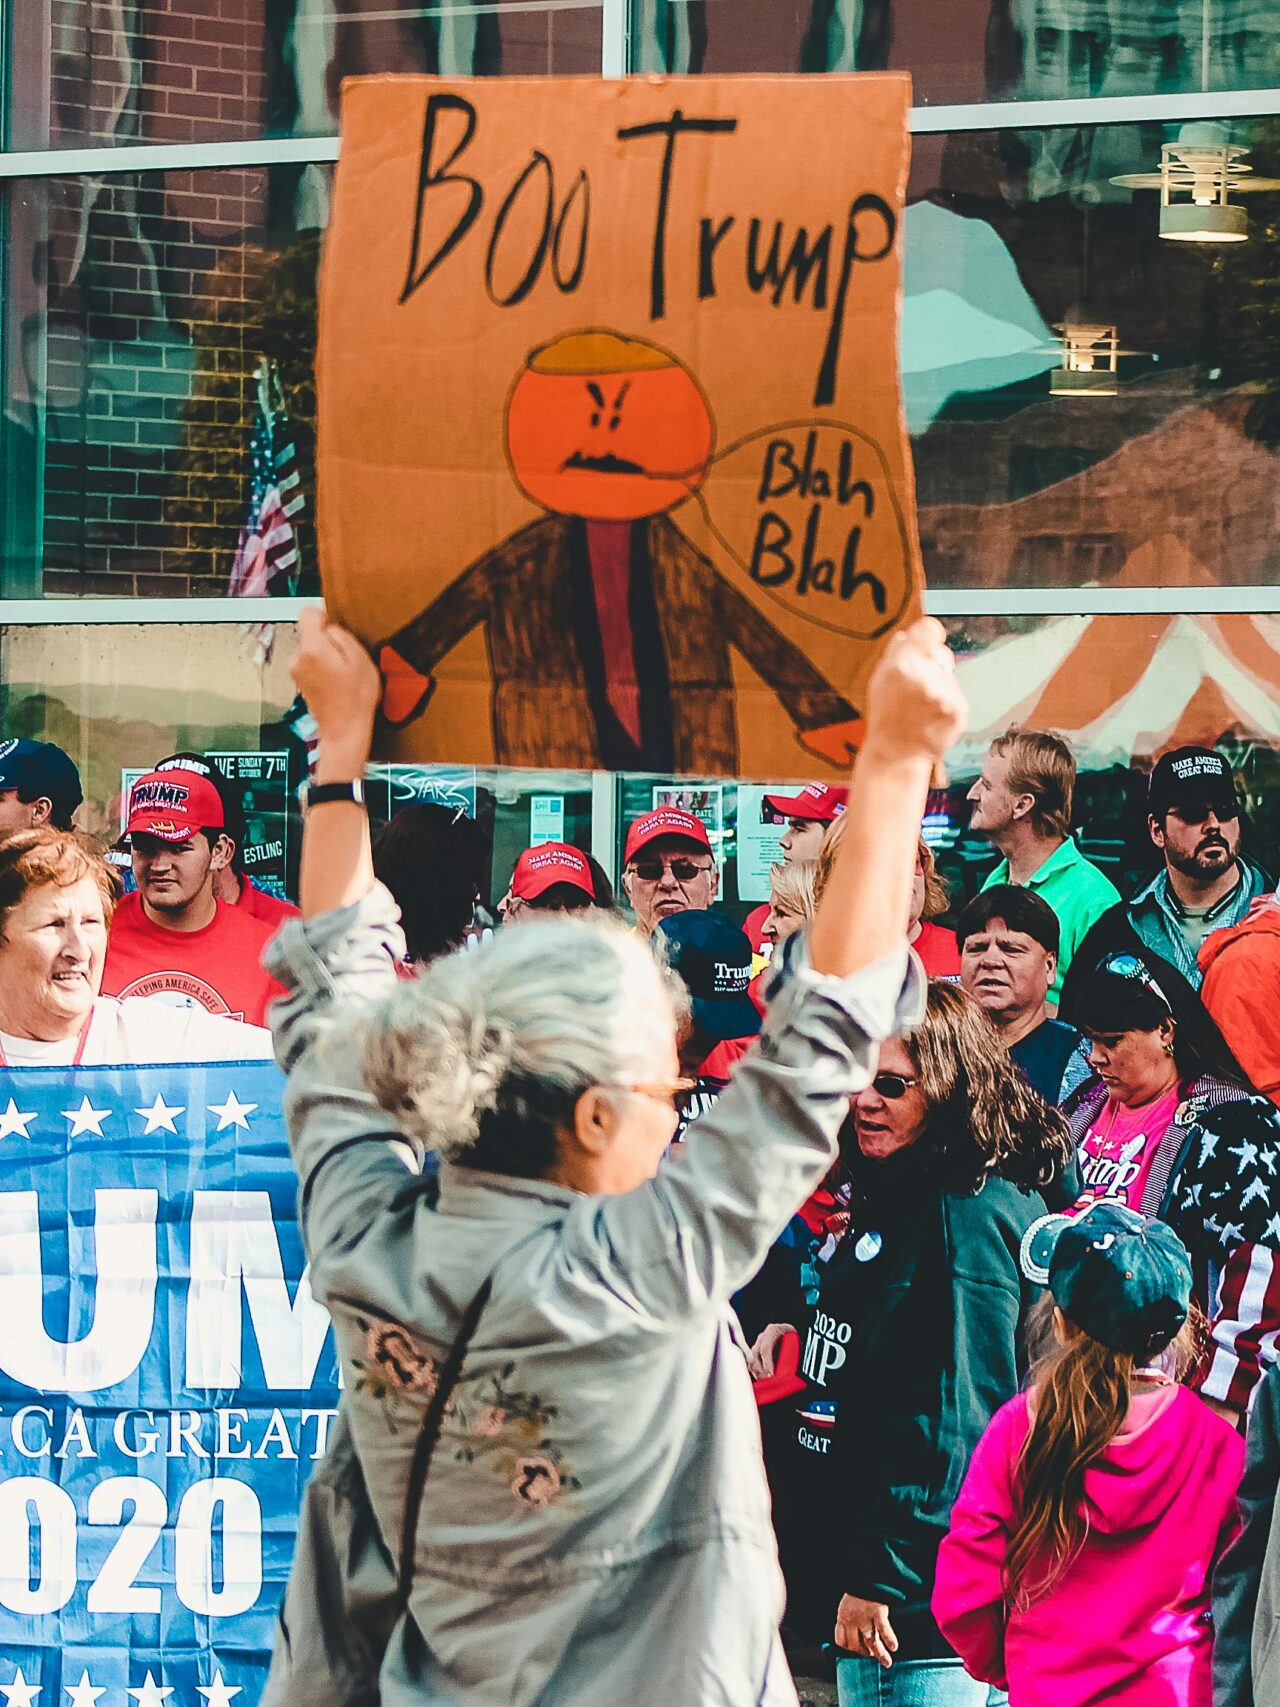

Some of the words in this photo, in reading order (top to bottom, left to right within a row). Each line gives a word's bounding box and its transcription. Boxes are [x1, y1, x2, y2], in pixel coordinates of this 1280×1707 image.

[398, 94, 591, 308] Boo
[617, 109, 897, 407] Trump
[758, 430, 875, 518] Blah
[749, 503, 887, 616] Blah
[237, 757, 262, 768] SUNDAY
[265, 757, 287, 779] 7TH
[165, 978, 201, 996] AMERICA
[199, 991, 219, 1011] SAFE
[813, 1308, 852, 1344] 2020
[113, 1408, 340, 1460] GREAT
